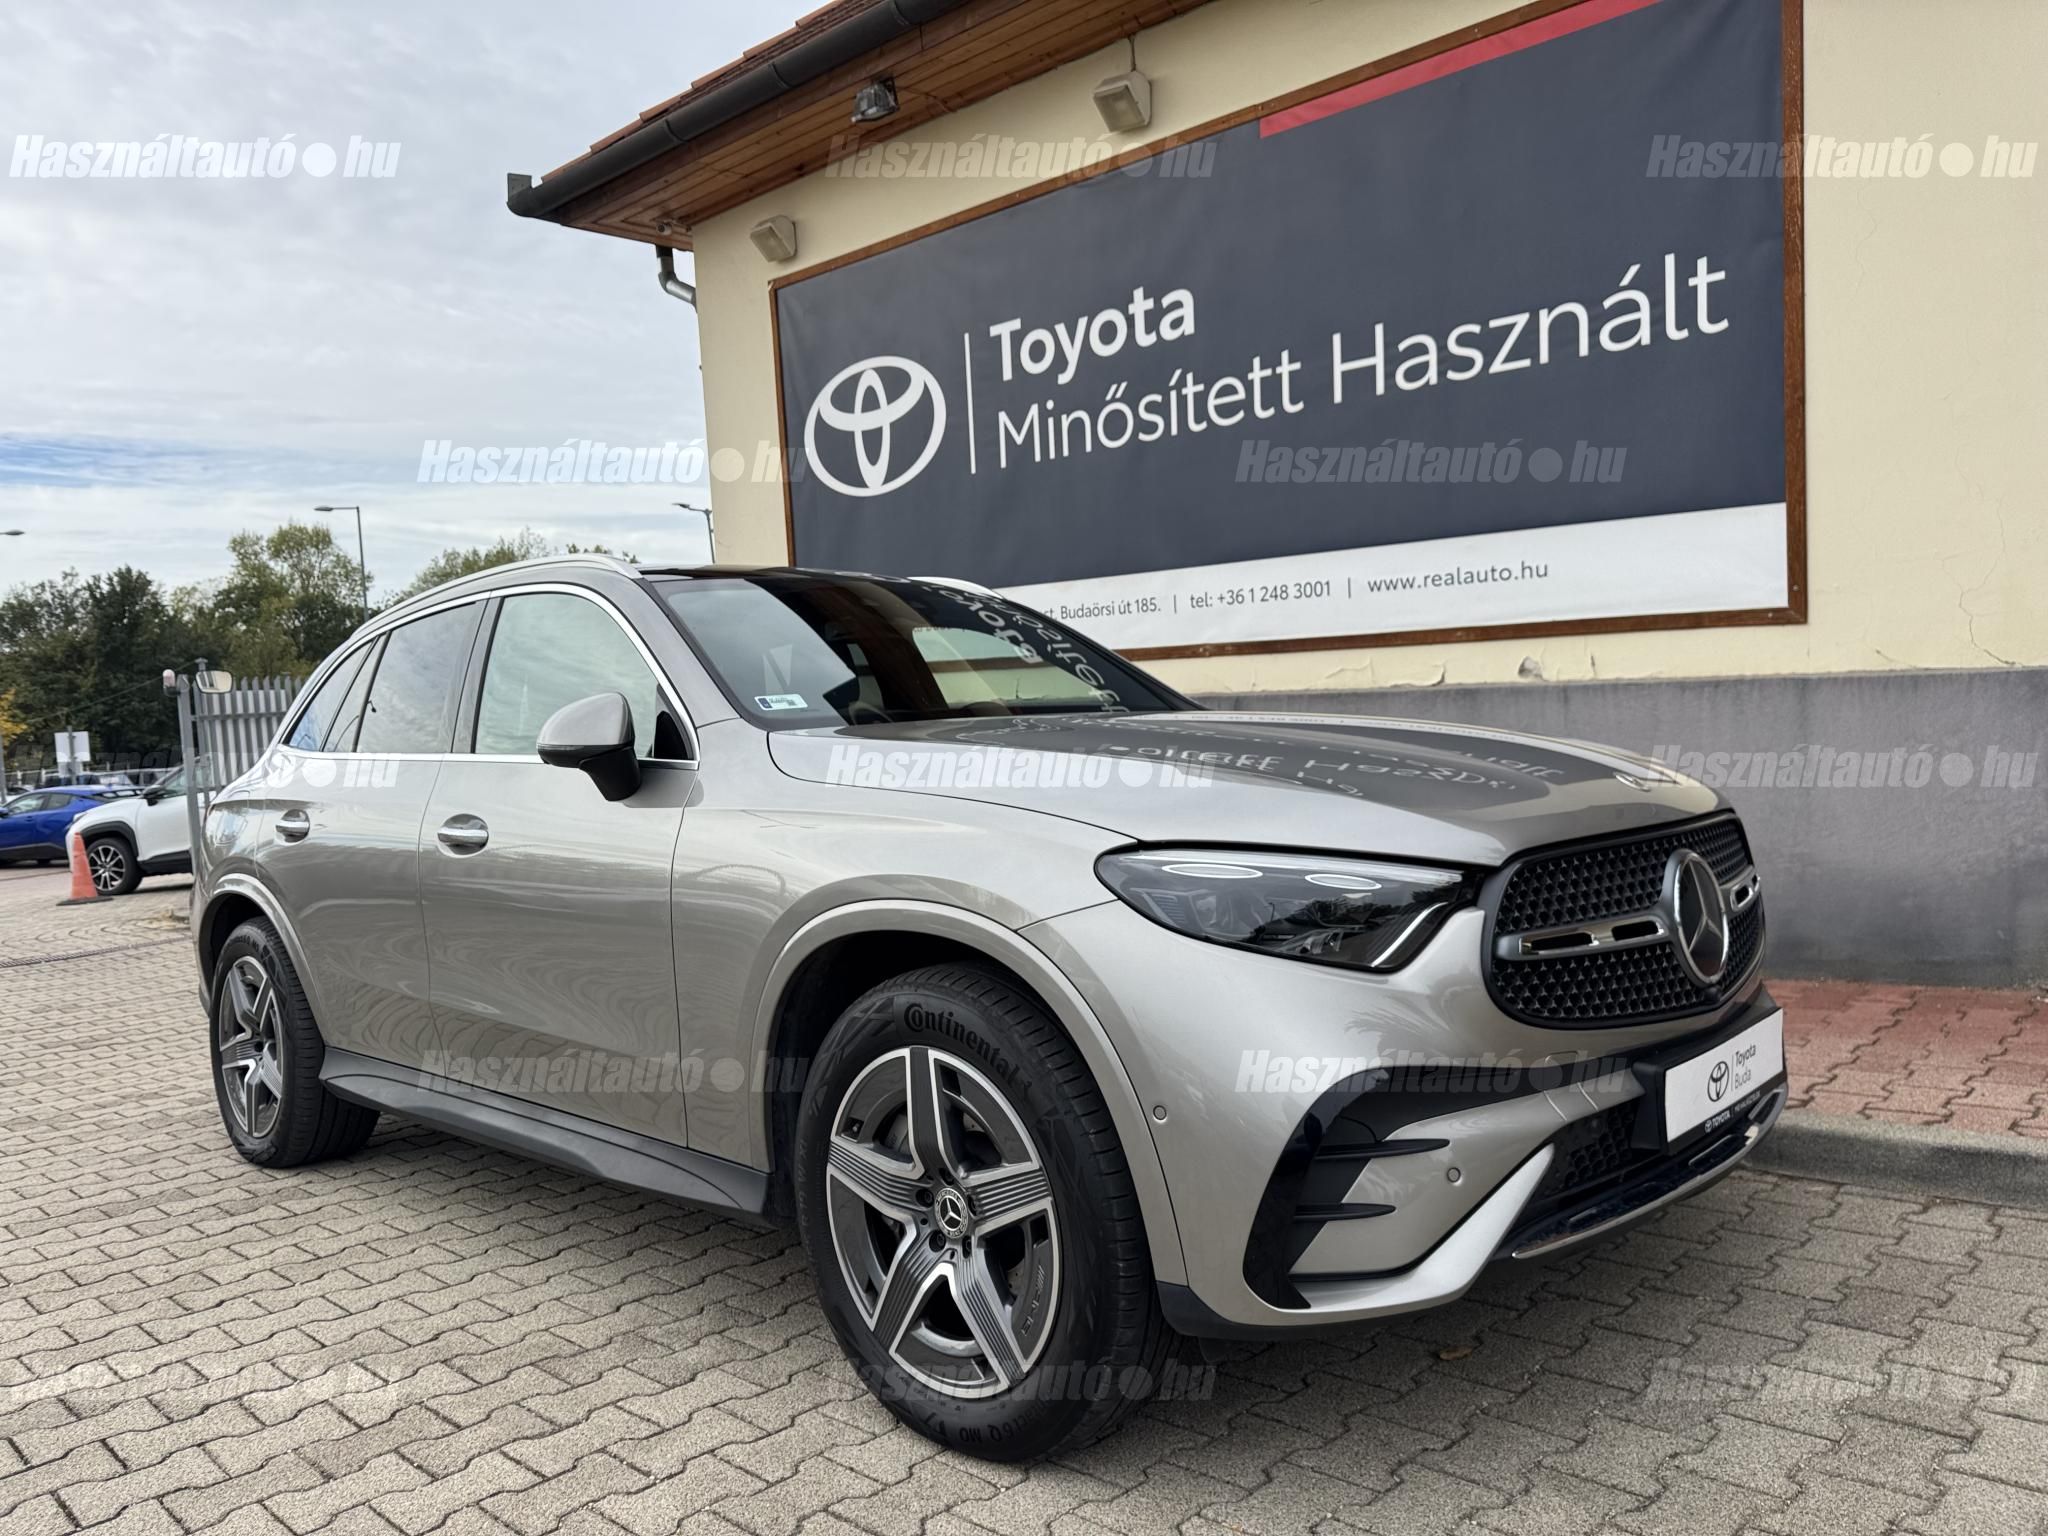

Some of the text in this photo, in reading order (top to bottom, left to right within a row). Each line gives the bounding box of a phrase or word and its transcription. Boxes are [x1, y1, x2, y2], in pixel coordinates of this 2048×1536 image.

[989, 286, 1196, 385] Toyota
[998, 252, 1730, 469] Minősített Használt
[1060, 602, 1115, 620] Budaörsi
[1118, 600, 1132, 615] út
[1135, 597, 1161, 613] 185.
[1190, 592, 1213, 609] tel:
[1217, 587, 1245, 606] +36
[1260, 585, 1289, 603] 248
[1295, 581, 1331, 599] 3001
[1367, 560, 1549, 593] www.realauto.hu
[904, 1003, 1020, 1087] Continental
[1735, 1043, 1757, 1067] Toyota
[1711, 1109, 1731, 1129] TOYOTA
